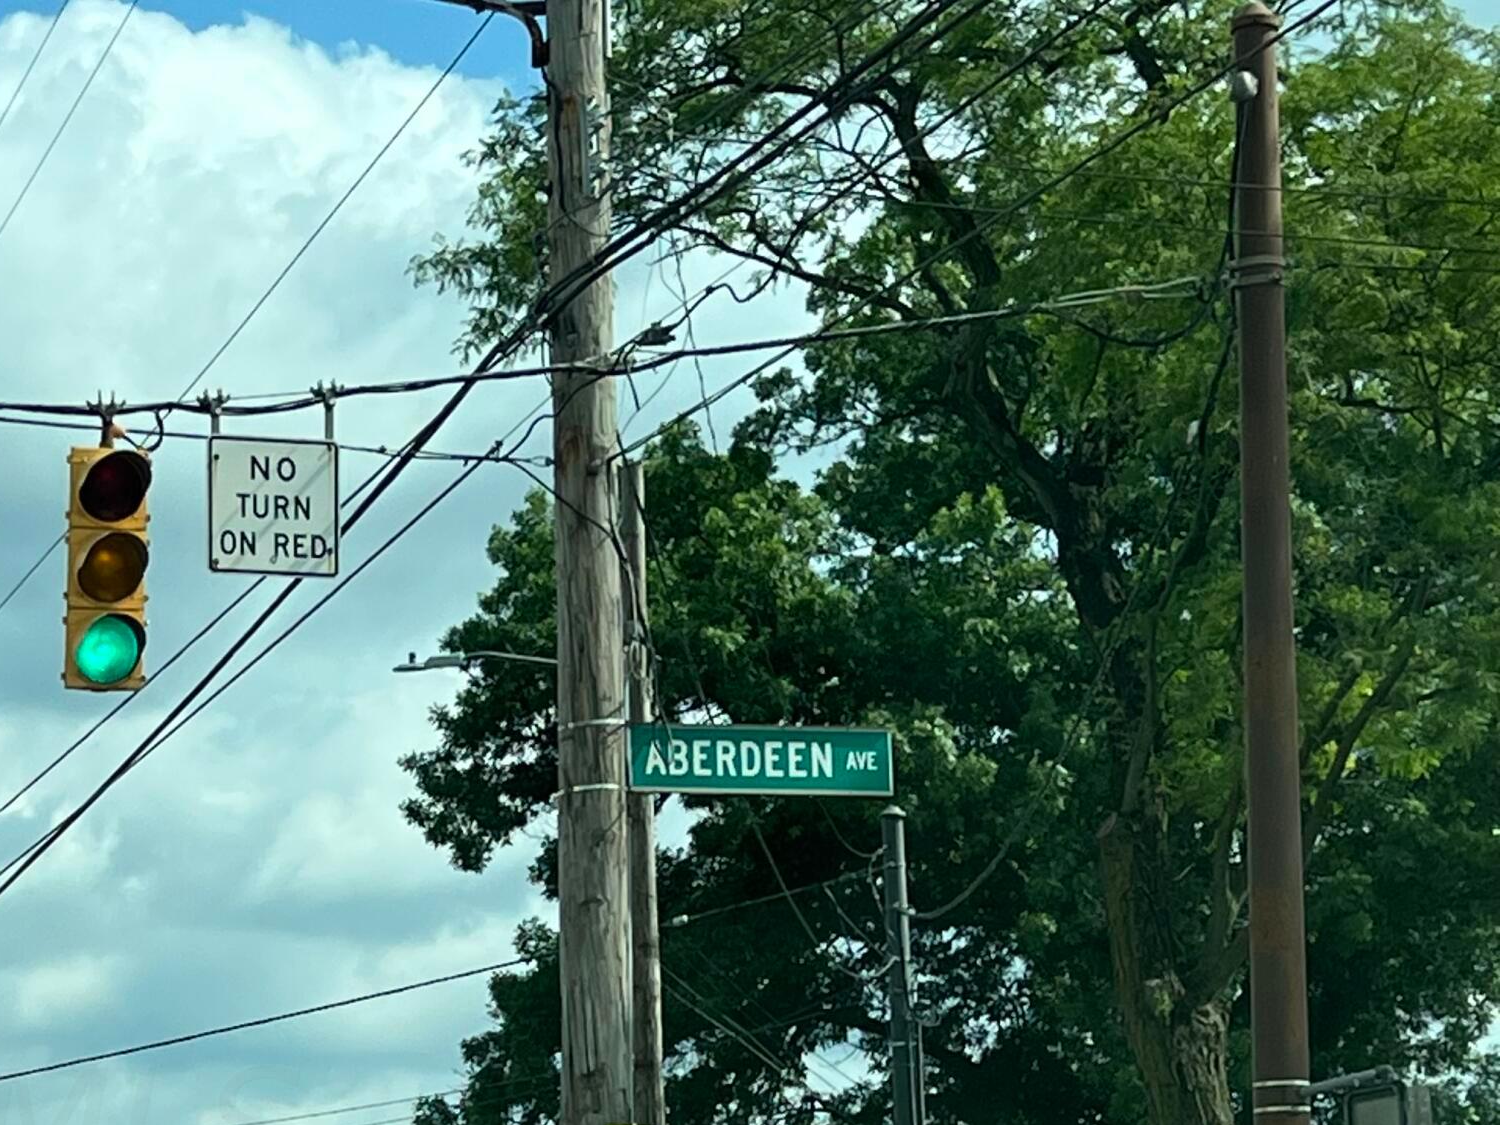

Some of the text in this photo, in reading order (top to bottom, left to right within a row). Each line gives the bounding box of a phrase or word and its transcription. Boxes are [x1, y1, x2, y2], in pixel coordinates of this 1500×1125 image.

[250, 455, 296, 482] NO
[236, 493, 311, 521] TURN
[220, 529, 327, 559] ON RED
[645, 739, 878, 778] ABERDEEN AVE
